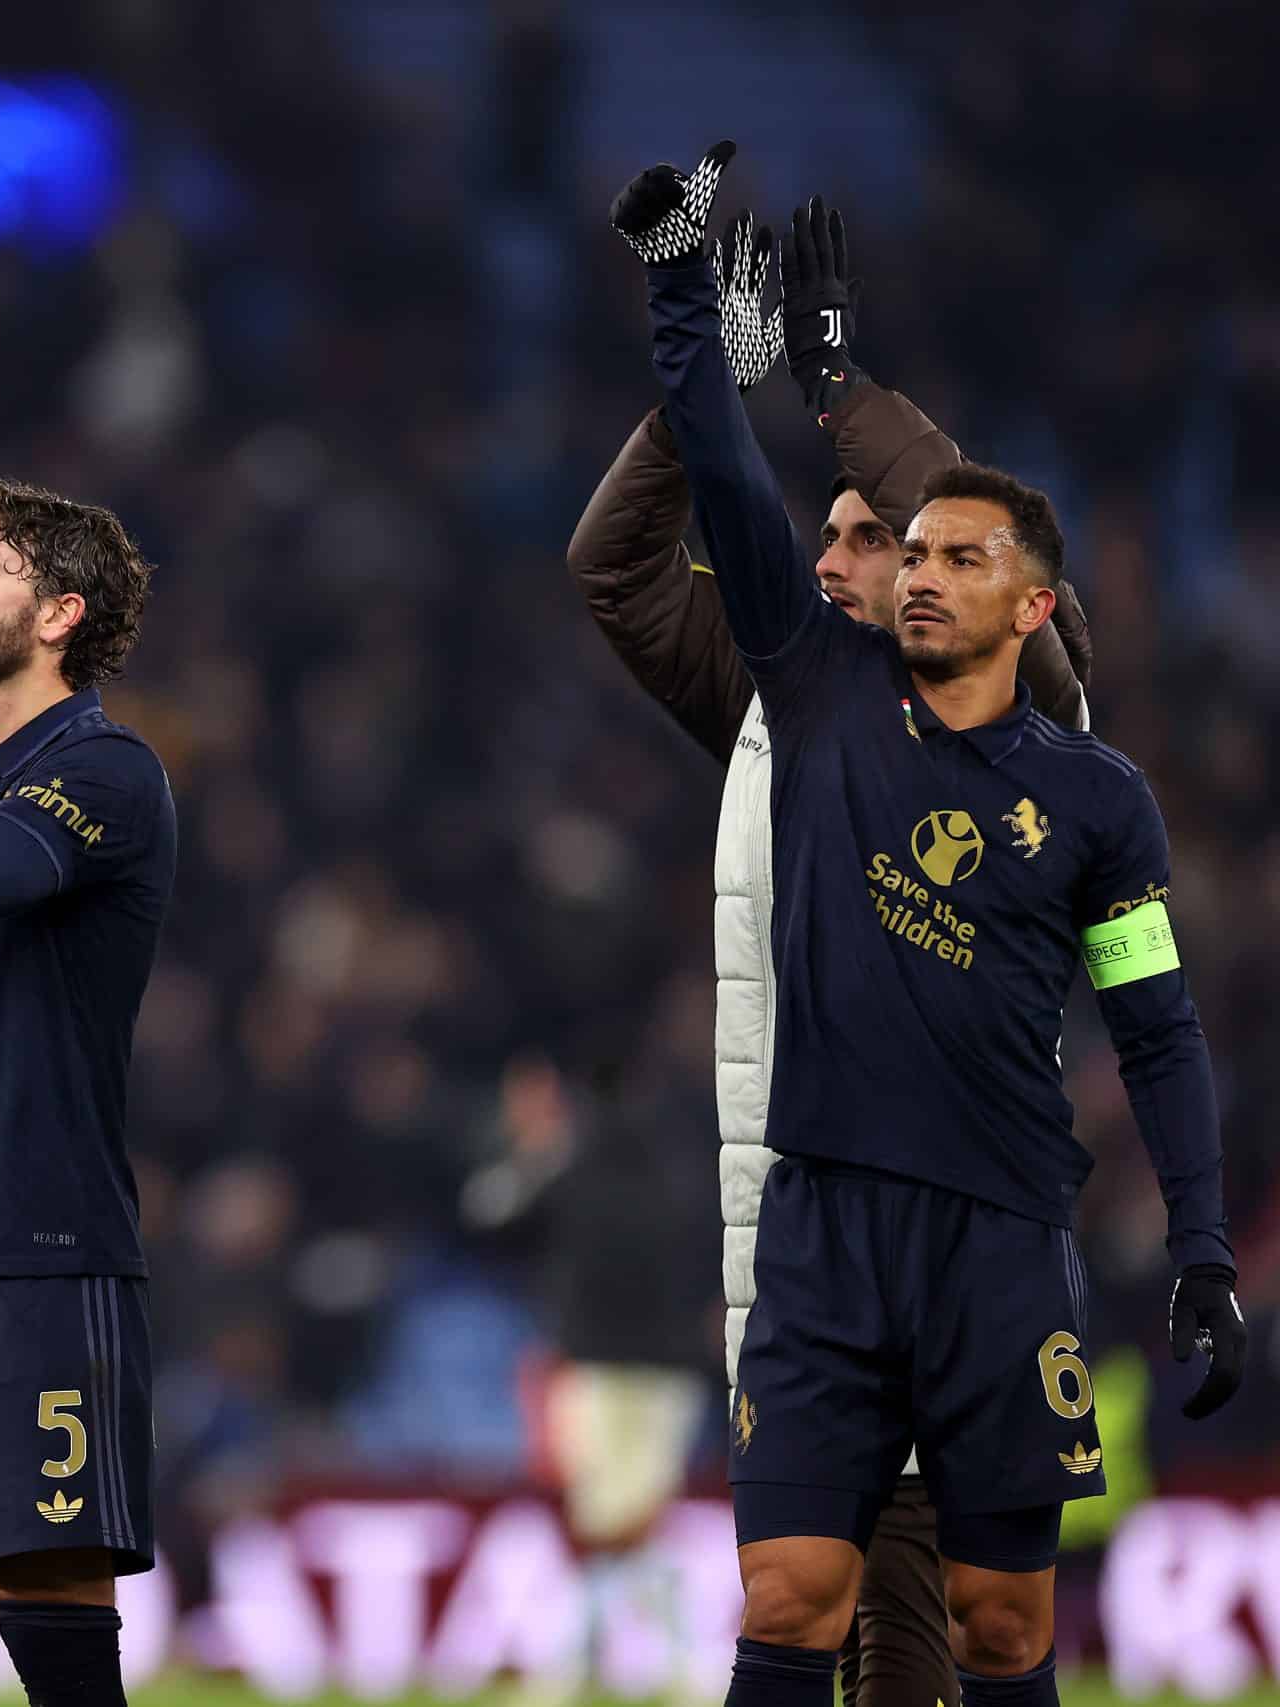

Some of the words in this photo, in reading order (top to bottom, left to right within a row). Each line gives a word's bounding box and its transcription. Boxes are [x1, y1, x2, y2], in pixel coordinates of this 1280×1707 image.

[865, 852, 930, 908] Save
[933, 899, 976, 943] the
[1038, 1330, 1093, 1420] 6
[37, 1389, 87, 1478] 5
